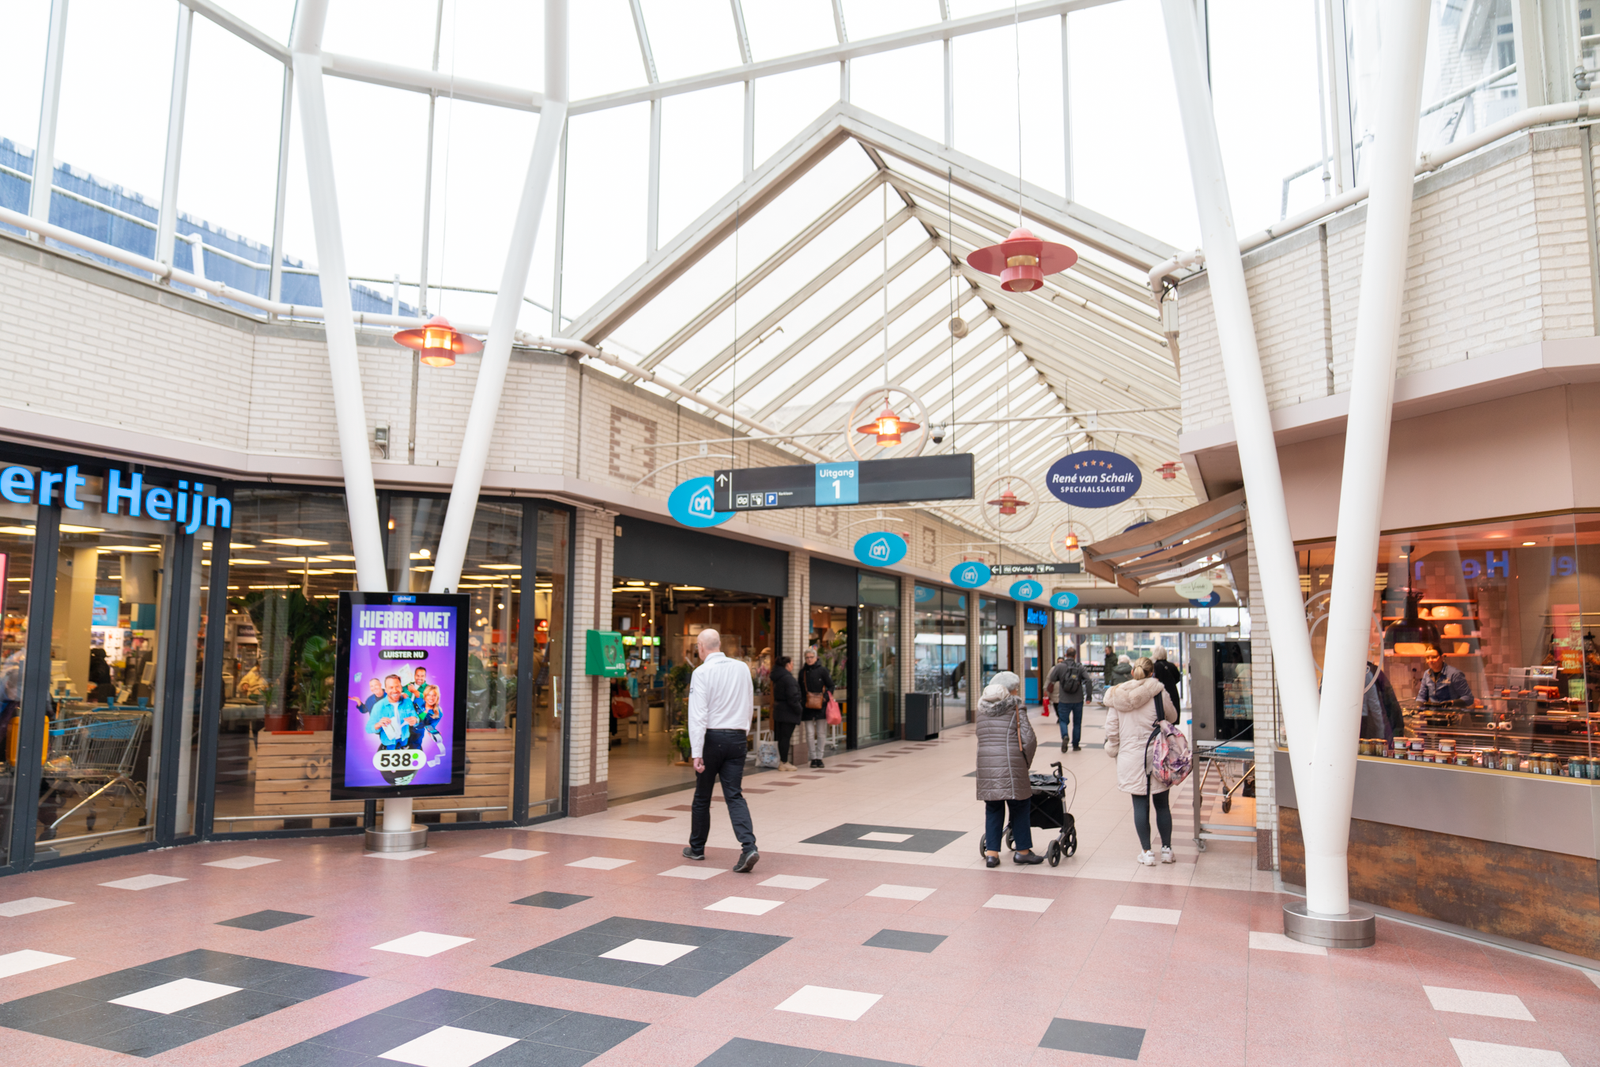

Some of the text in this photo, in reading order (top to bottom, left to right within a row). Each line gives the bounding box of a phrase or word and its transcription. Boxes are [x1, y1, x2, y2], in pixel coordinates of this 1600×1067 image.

[819, 469, 855, 479] Uitgang
[1052, 473, 1134, 483] René van Schaik
[832, 480, 841, 499] 1
[107, 468, 232, 534] Heijn
[359, 610, 451, 629] HIERRR MET
[358, 630, 449, 647] JE REKENING!
[380, 753, 411, 767] 538
